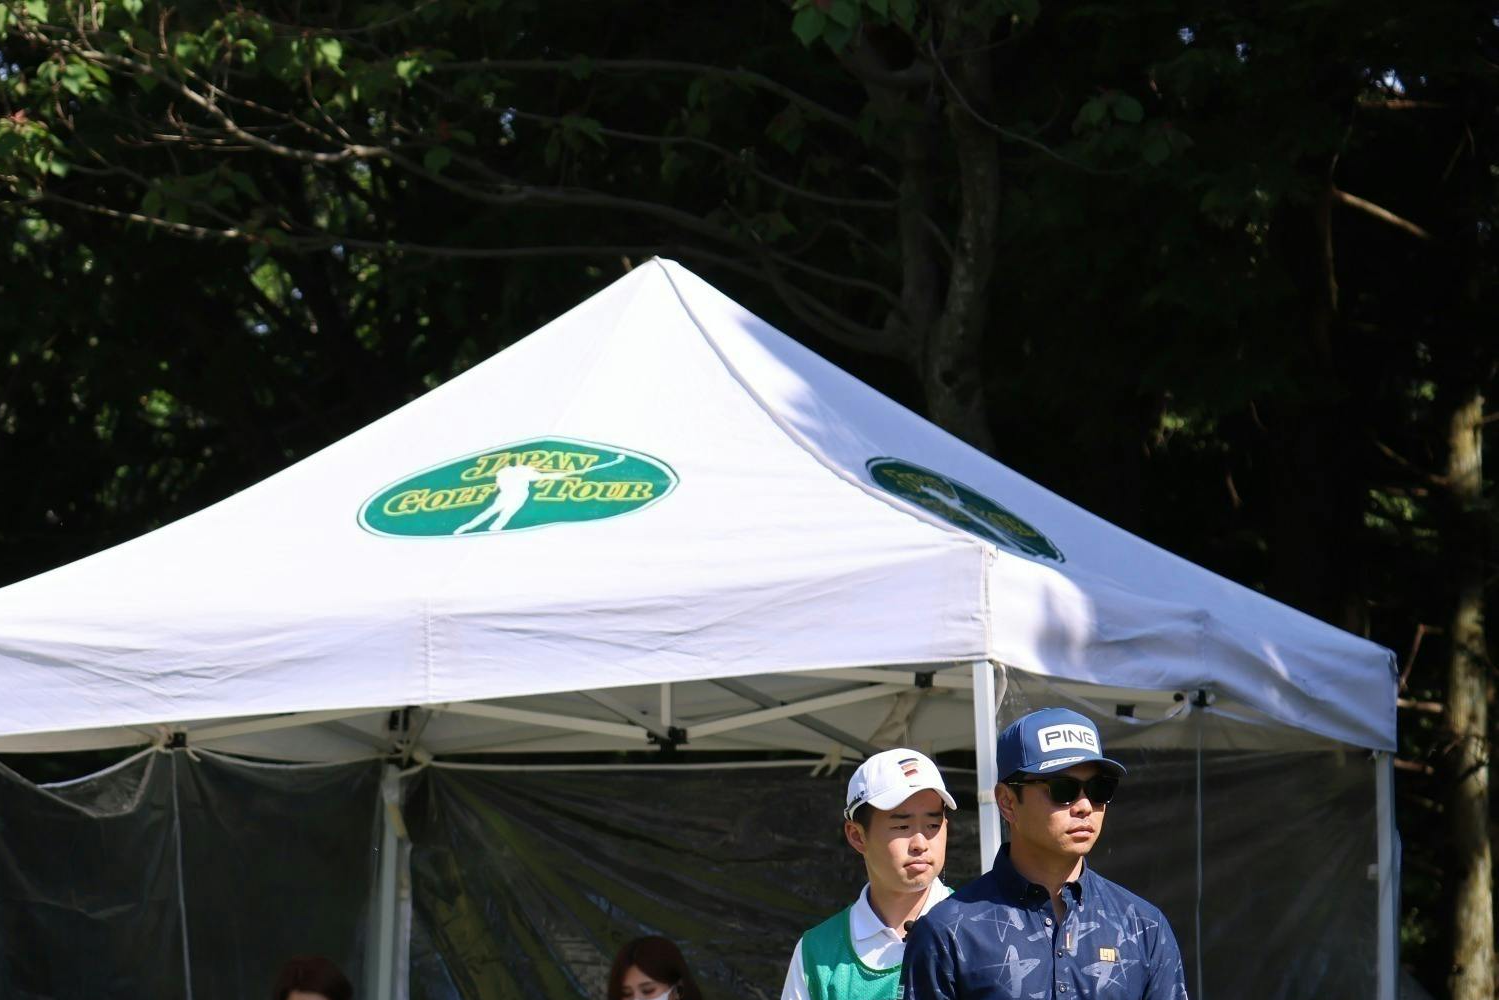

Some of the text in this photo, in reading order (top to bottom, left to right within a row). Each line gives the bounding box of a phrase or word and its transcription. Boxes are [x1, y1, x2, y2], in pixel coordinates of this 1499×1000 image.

[461, 450, 599, 481] JAPAN
[384, 477, 654, 516] GOLF TOUR
[1045, 730, 1095, 747] PING
